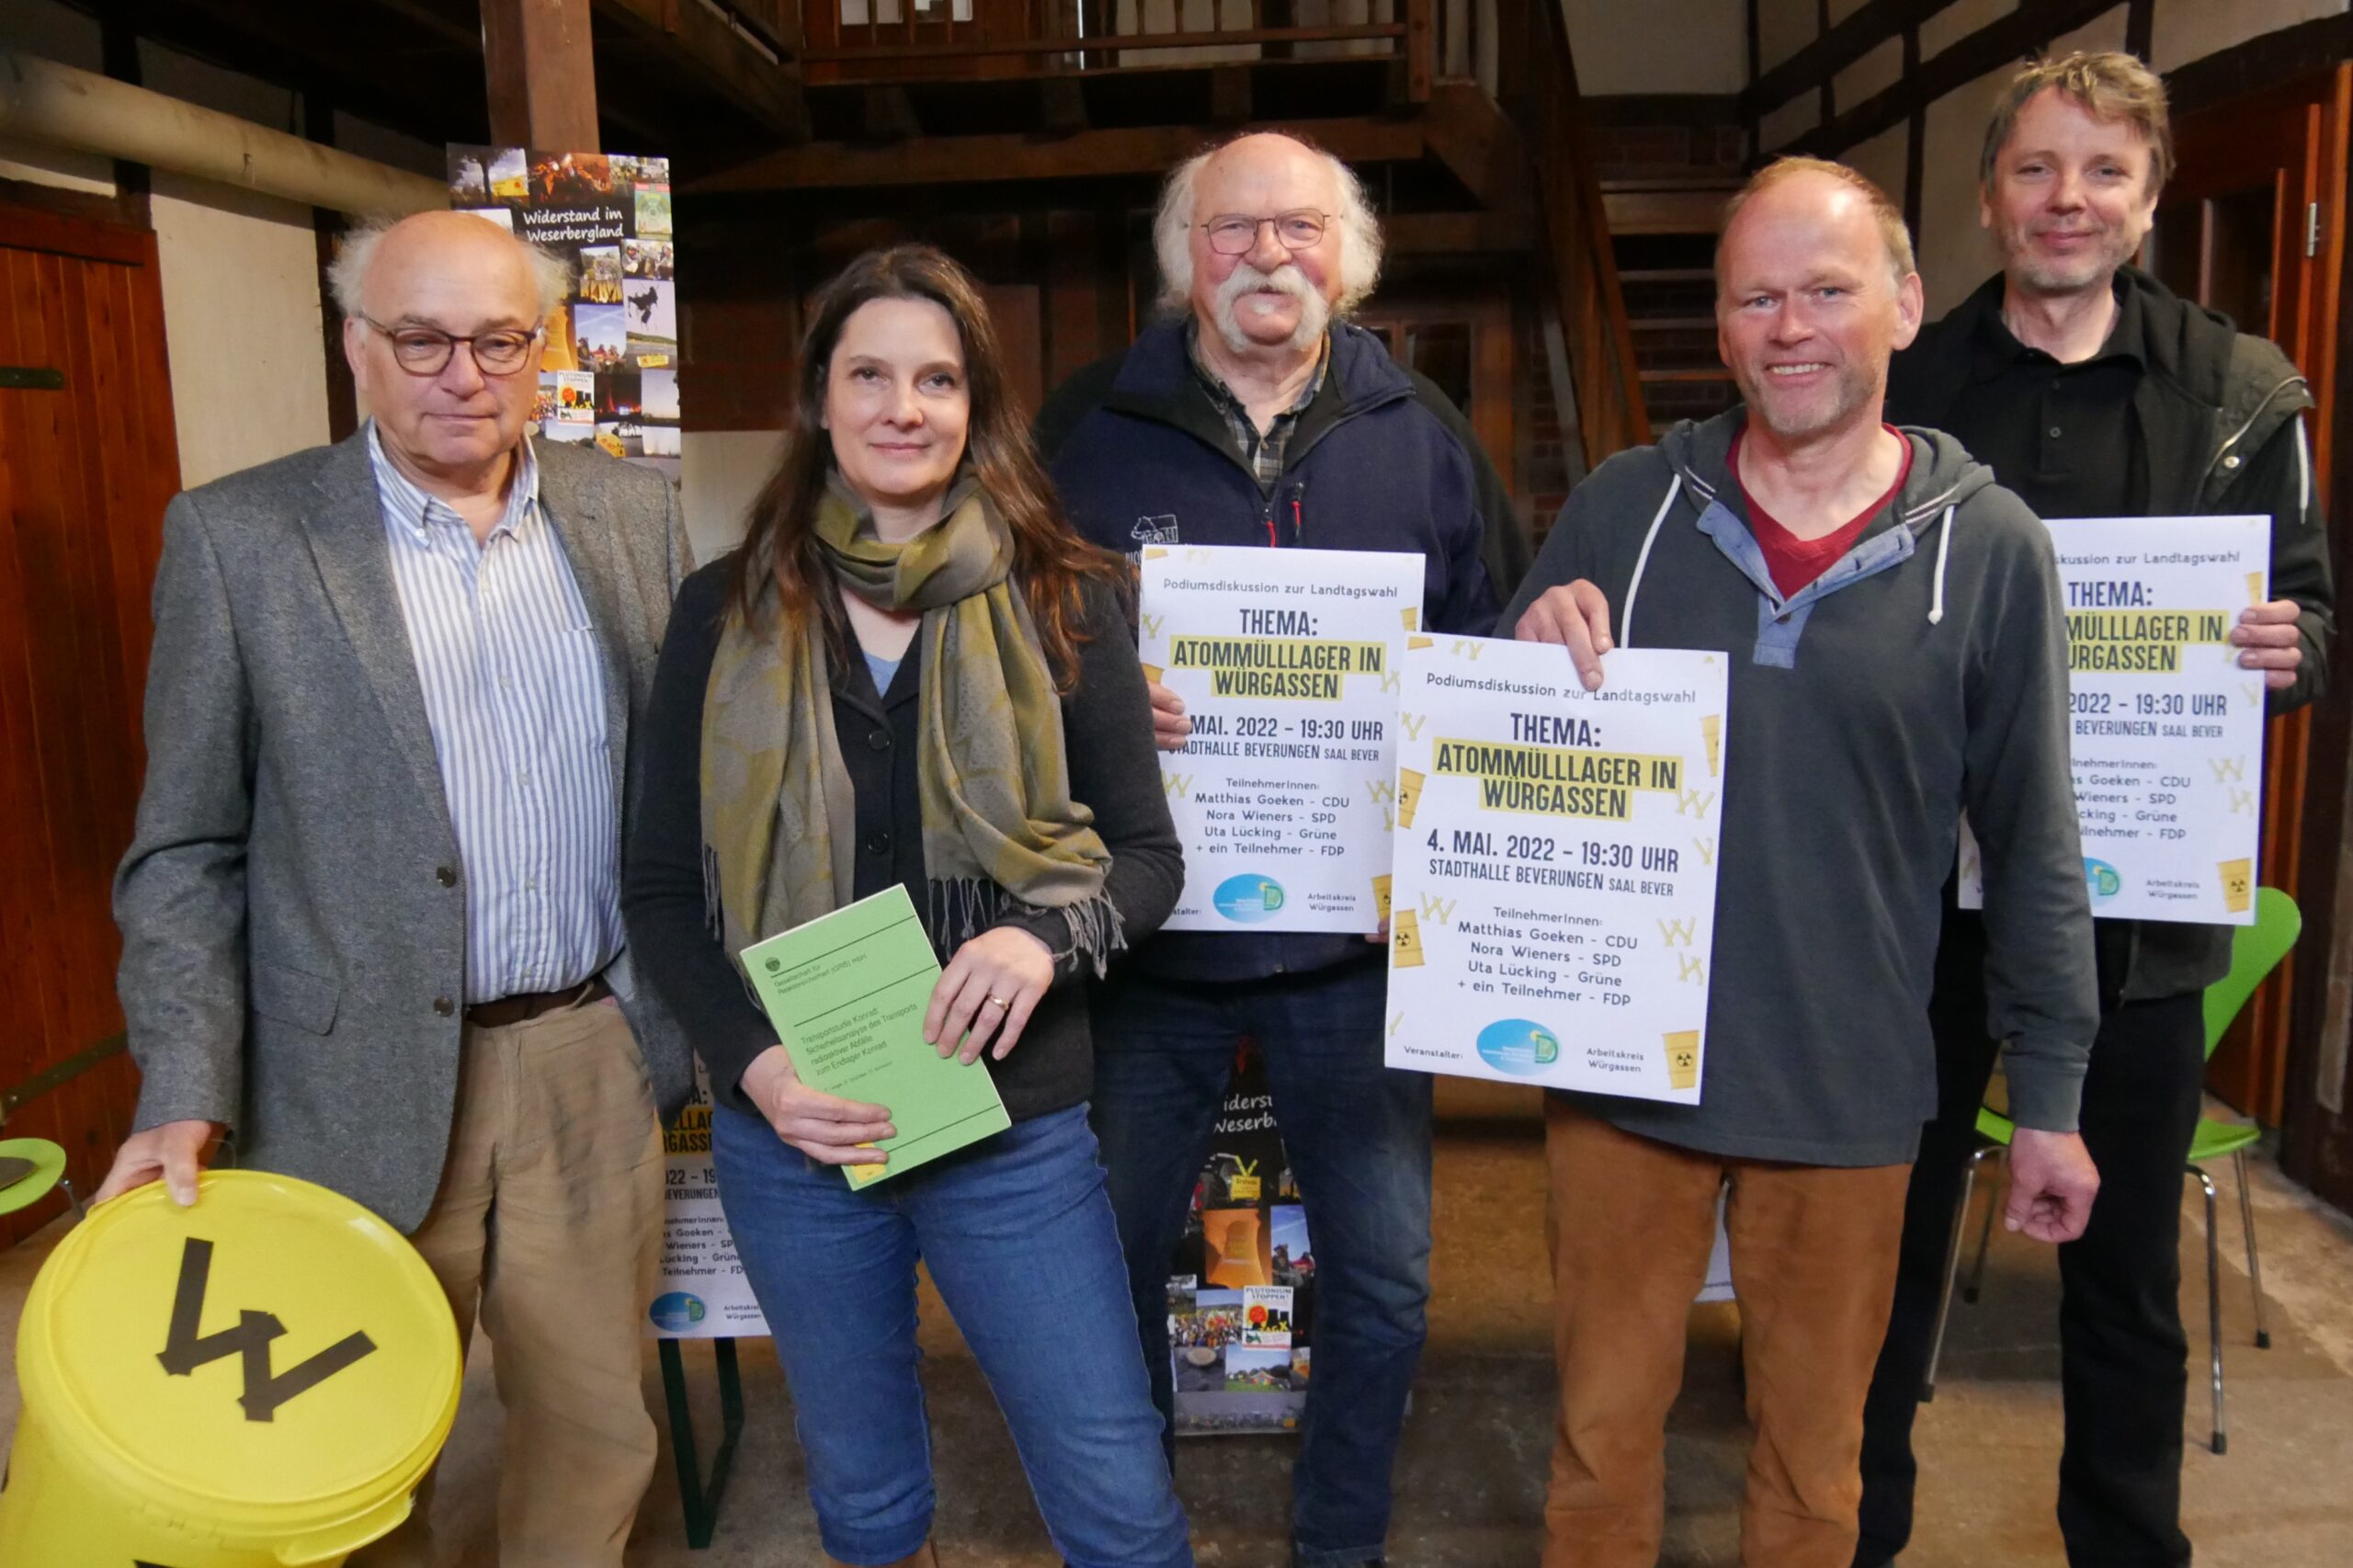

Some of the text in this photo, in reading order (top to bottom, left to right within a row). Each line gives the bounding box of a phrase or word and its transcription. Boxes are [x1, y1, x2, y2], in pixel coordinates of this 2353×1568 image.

[523, 206, 623, 224] Widerstand im
[527, 222, 624, 244] Weserbergland
[2116, 555, 2137, 564] zur
[2143, 551, 2240, 566] Landtagswahl
[1164, 578, 1398, 599] Podiumsdiskussion zur Landtagswahl
[2068, 581, 2153, 607] THEMA:
[1240, 608, 1318, 636] THEMA:
[2200, 616, 2222, 641] IN
[1174, 637, 1381, 672] ATOMMÜLLLAGER IN
[1215, 667, 1338, 699] WÜRGASSEN
[1427, 673, 1696, 706] Podiumsdiskussion zur Landtagswahl
[2069, 692, 2110, 714] 2022
[2136, 693, 2184, 715] 19:30
[2192, 695, 2227, 716] UHR
[1189, 715, 1228, 735] MAI.
[1236, 717, 1278, 737] 2022
[1301, 719, 1345, 739] 19:30
[1351, 721, 1383, 741] UHR
[1511, 713, 1601, 747] THEMA:
[2075, 720, 2223, 737] BEVERUNGEN SAAL BEVER
[1245, 744, 1320, 759] BEVERUNGEN
[1324, 747, 1347, 761] SAAL
[1351, 748, 1379, 762] BEVER
[1437, 744, 1677, 790] ATOMMÜLLLAGER IN
[1225, 778, 1320, 790] TeilnehmerInnen:
[2089, 775, 2140, 787] Goeken
[2160, 777, 2191, 788] CDU
[1195, 792, 1251, 805] Matthias
[1257, 794, 1303, 806] Goeken
[1322, 796, 1349, 808] CDU
[1483, 776, 1626, 818] WÜRGASSEN
[2075, 792, 2129, 804] Wieners
[2149, 793, 2177, 805] SPD
[1207, 810, 1234, 821] Nora
[1242, 810, 1292, 823] Wieners
[1311, 812, 1336, 824] SPD
[2135, 811, 2177, 823] Grüne
[1205, 826, 1226, 837] Uta
[1232, 825, 1281, 841] Lücking
[1299, 828, 1337, 840] Grüne
[2160, 829, 2186, 840] FDP
[1209, 843, 1227, 854] ein
[1233, 843, 1302, 856] Teilnehmer
[1321, 846, 1345, 857] FDP
[1427, 829, 1444, 852] 4.
[1453, 831, 1498, 857] MAI.
[1506, 835, 1554, 862] 2022
[1582, 841, 1632, 869] 19:30
[1642, 846, 1678, 873] UHR
[1429, 858, 1673, 896] STADTHALLE BEVERUNGEN SAAL BEVER
[2145, 879, 2200, 889] Arbeitskreis
[1308, 892, 1356, 902] Arbeitskreis
[2148, 890, 2199, 901] Würgassen
[1309, 903, 1354, 913] Würgassen
[1493, 907, 1602, 926] TeilnehmerInnen:
[1458, 922, 1522, 938] Matthias
[1529, 929, 1584, 945] Goeken
[1605, 935, 1638, 949] CDU
[1471, 941, 1503, 956] Nora
[1511, 945, 1571, 962] Wieners
[1593, 954, 1621, 968] SPD
[1468, 960, 1492, 974] Uta
[1499, 963, 1556, 983] Lücking
[1578, 971, 1622, 987] Grüne
[1472, 981, 1495, 993] ein
[1502, 983, 1582, 1003] Teilnehmer
[1603, 993, 1631, 1006] FDP
[801, 1020, 853, 1044] Transportstudie
[805, 1003, 918, 1055] Sicherheitsanalyse des Transports
[811, 1046, 848, 1065] radioaktiver
[861, 1040, 887, 1056] Konrad
[1404, 1046, 1462, 1060] Veranstalter:
[1586, 1048, 1644, 1061] Arbeitskreis
[1588, 1061, 1642, 1074] Würgassen
[676, 1228, 713, 1237] Goeken
[665, 1241, 706, 1250] Wieners
[663, 1267, 716, 1277] Teilnehmer
